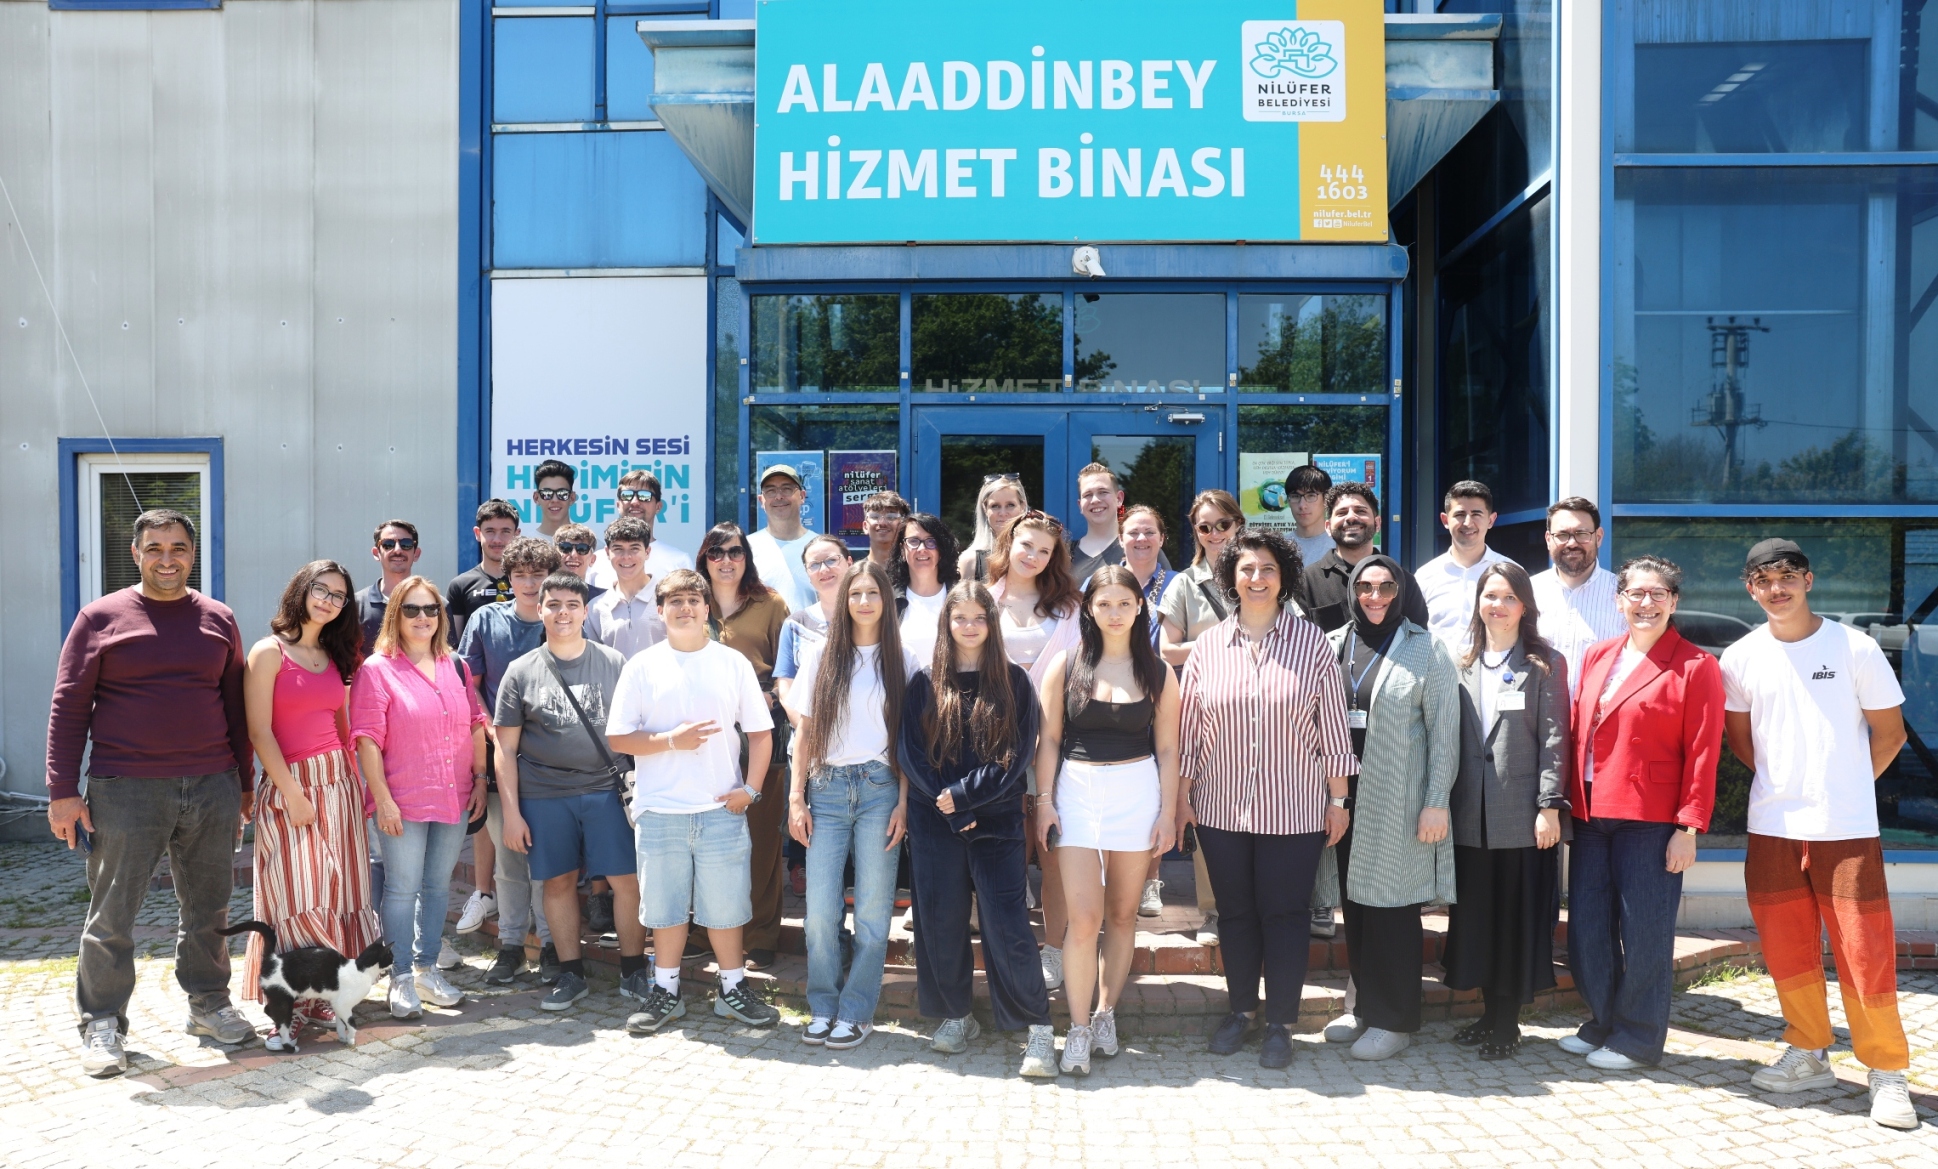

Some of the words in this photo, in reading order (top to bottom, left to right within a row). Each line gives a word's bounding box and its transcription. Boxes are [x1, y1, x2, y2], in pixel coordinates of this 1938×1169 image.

[777, 45, 1217, 113] ALAADDİNBEY
[1258, 81, 1332, 95] NİLÜFER
[1258, 97, 1331, 107] BELEDİYESİ
[778, 135, 1017, 201] HİZMET
[1037, 132, 1246, 199] BİNASI
[1319, 164, 1364, 183] 444
[1316, 182, 1368, 200] 1603
[1313, 209, 1372, 218] nilufer.bel.tr
[506, 435, 629, 456] HERKESİN
[636, 434, 690, 455] SESİ
[844, 470, 881, 478] nilüfer
[1812, 671, 1836, 680] IBIS
